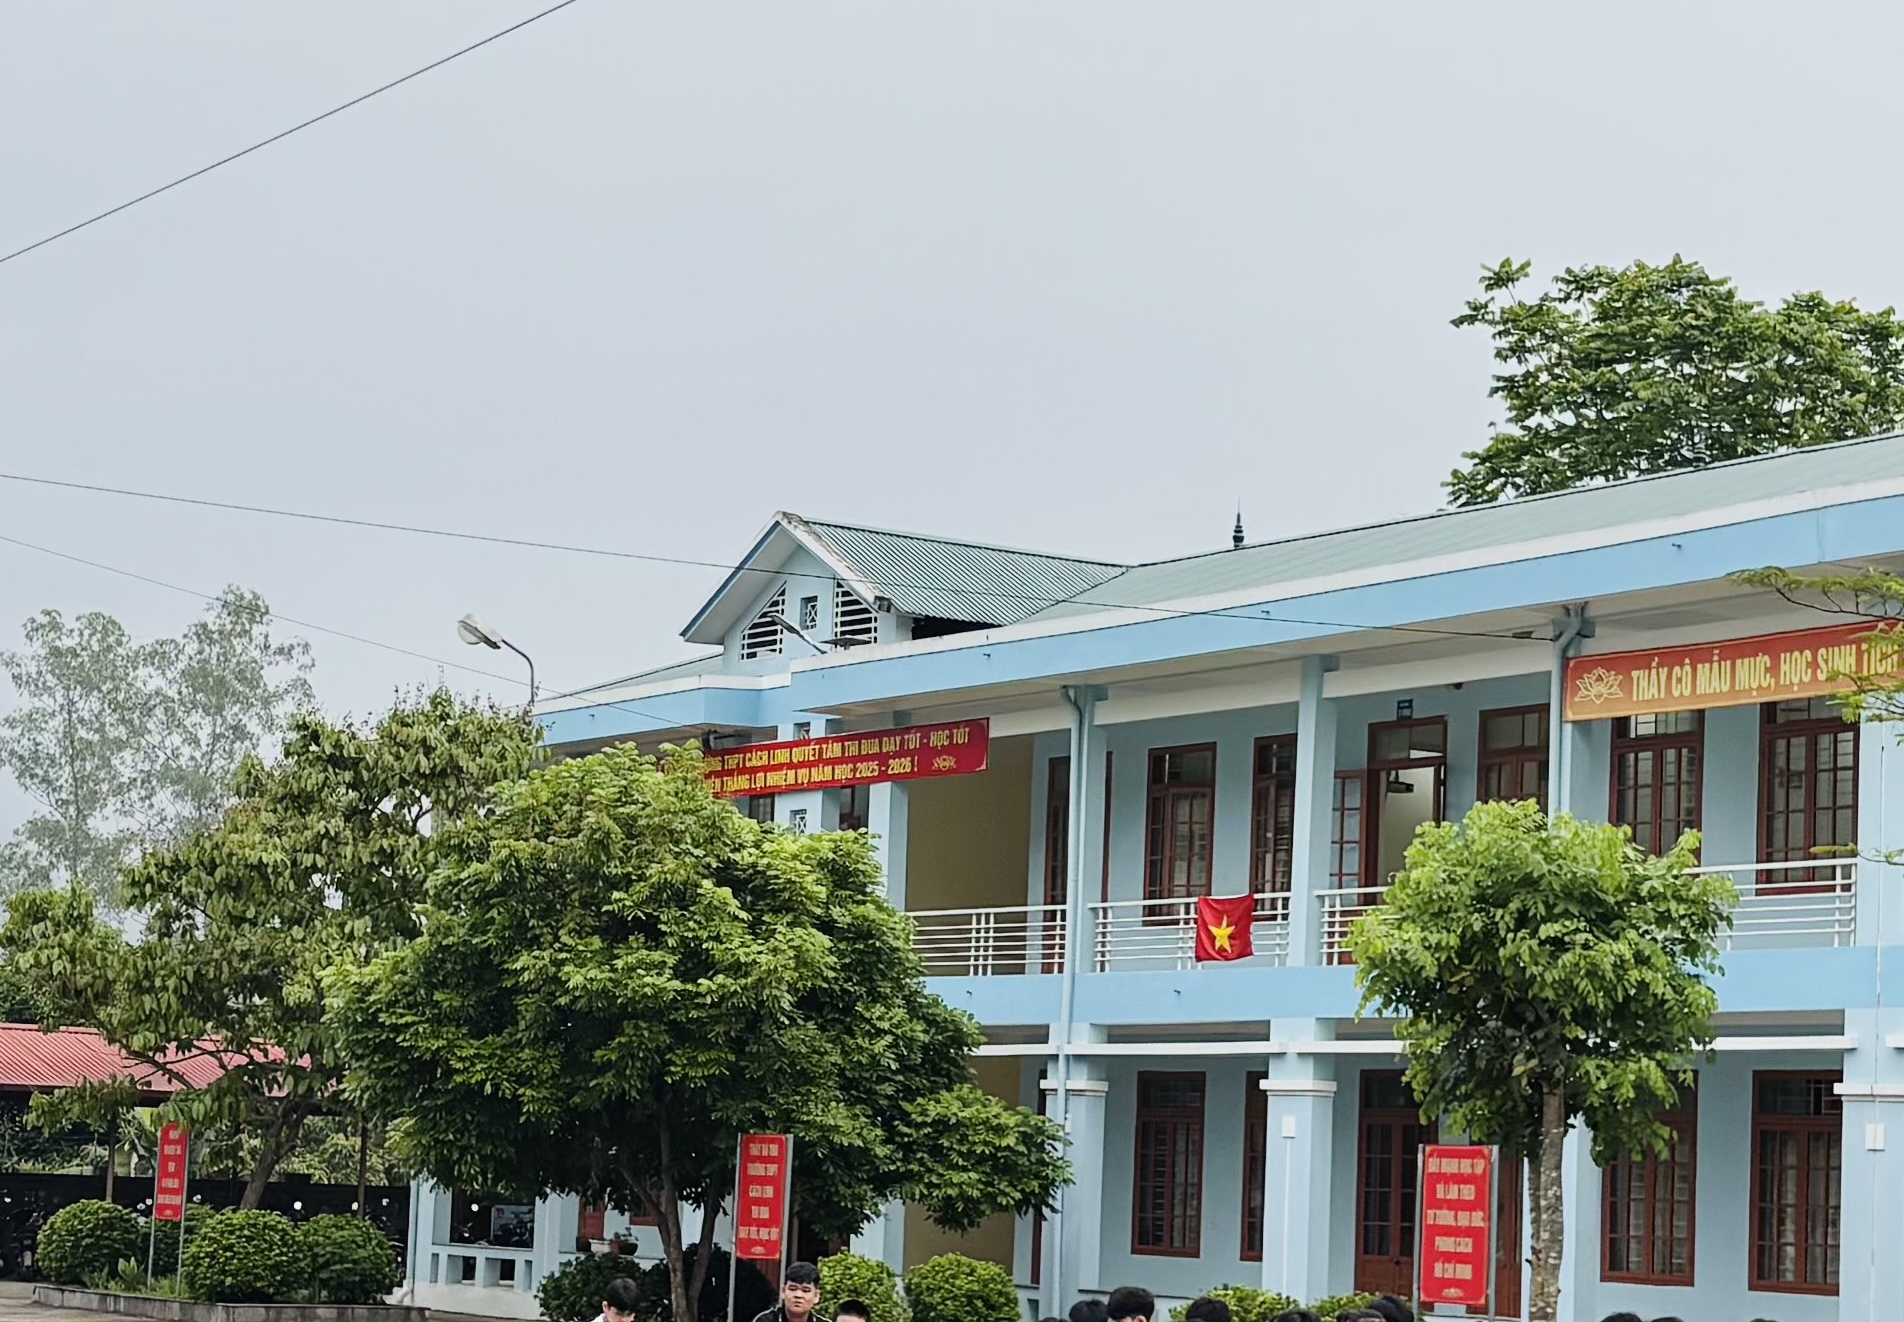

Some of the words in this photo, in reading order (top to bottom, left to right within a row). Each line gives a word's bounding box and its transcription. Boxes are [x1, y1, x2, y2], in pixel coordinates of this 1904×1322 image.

[1672, 657, 1692, 697] CÔ
[1780, 649, 1812, 692] HỌC
[1816, 643, 1857, 681] SINH
[930, 730, 950, 750] HỌC
